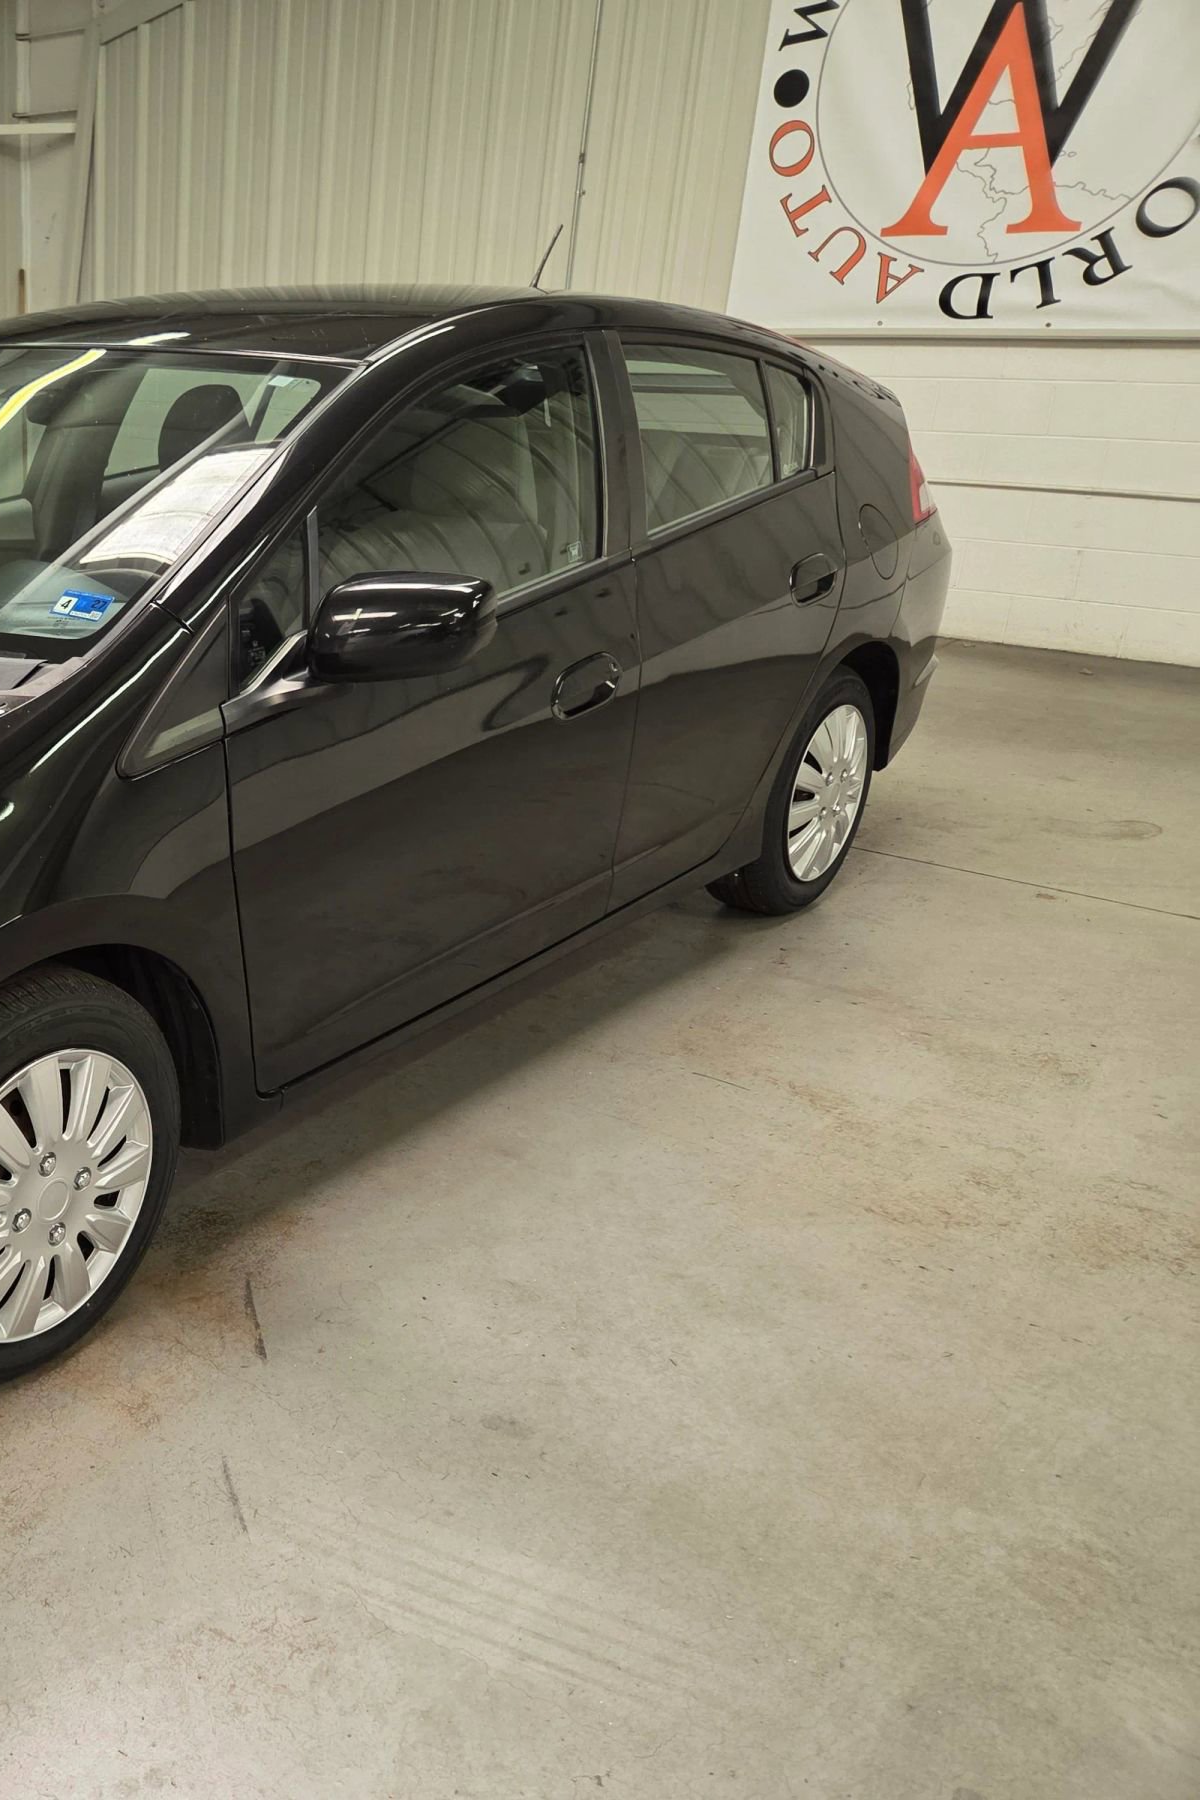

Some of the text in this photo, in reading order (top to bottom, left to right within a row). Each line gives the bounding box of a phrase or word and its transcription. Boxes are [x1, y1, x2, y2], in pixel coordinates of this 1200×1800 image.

[769, 119, 1200, 320] ORLD AUTO
[61, 599, 73, 609] 4
